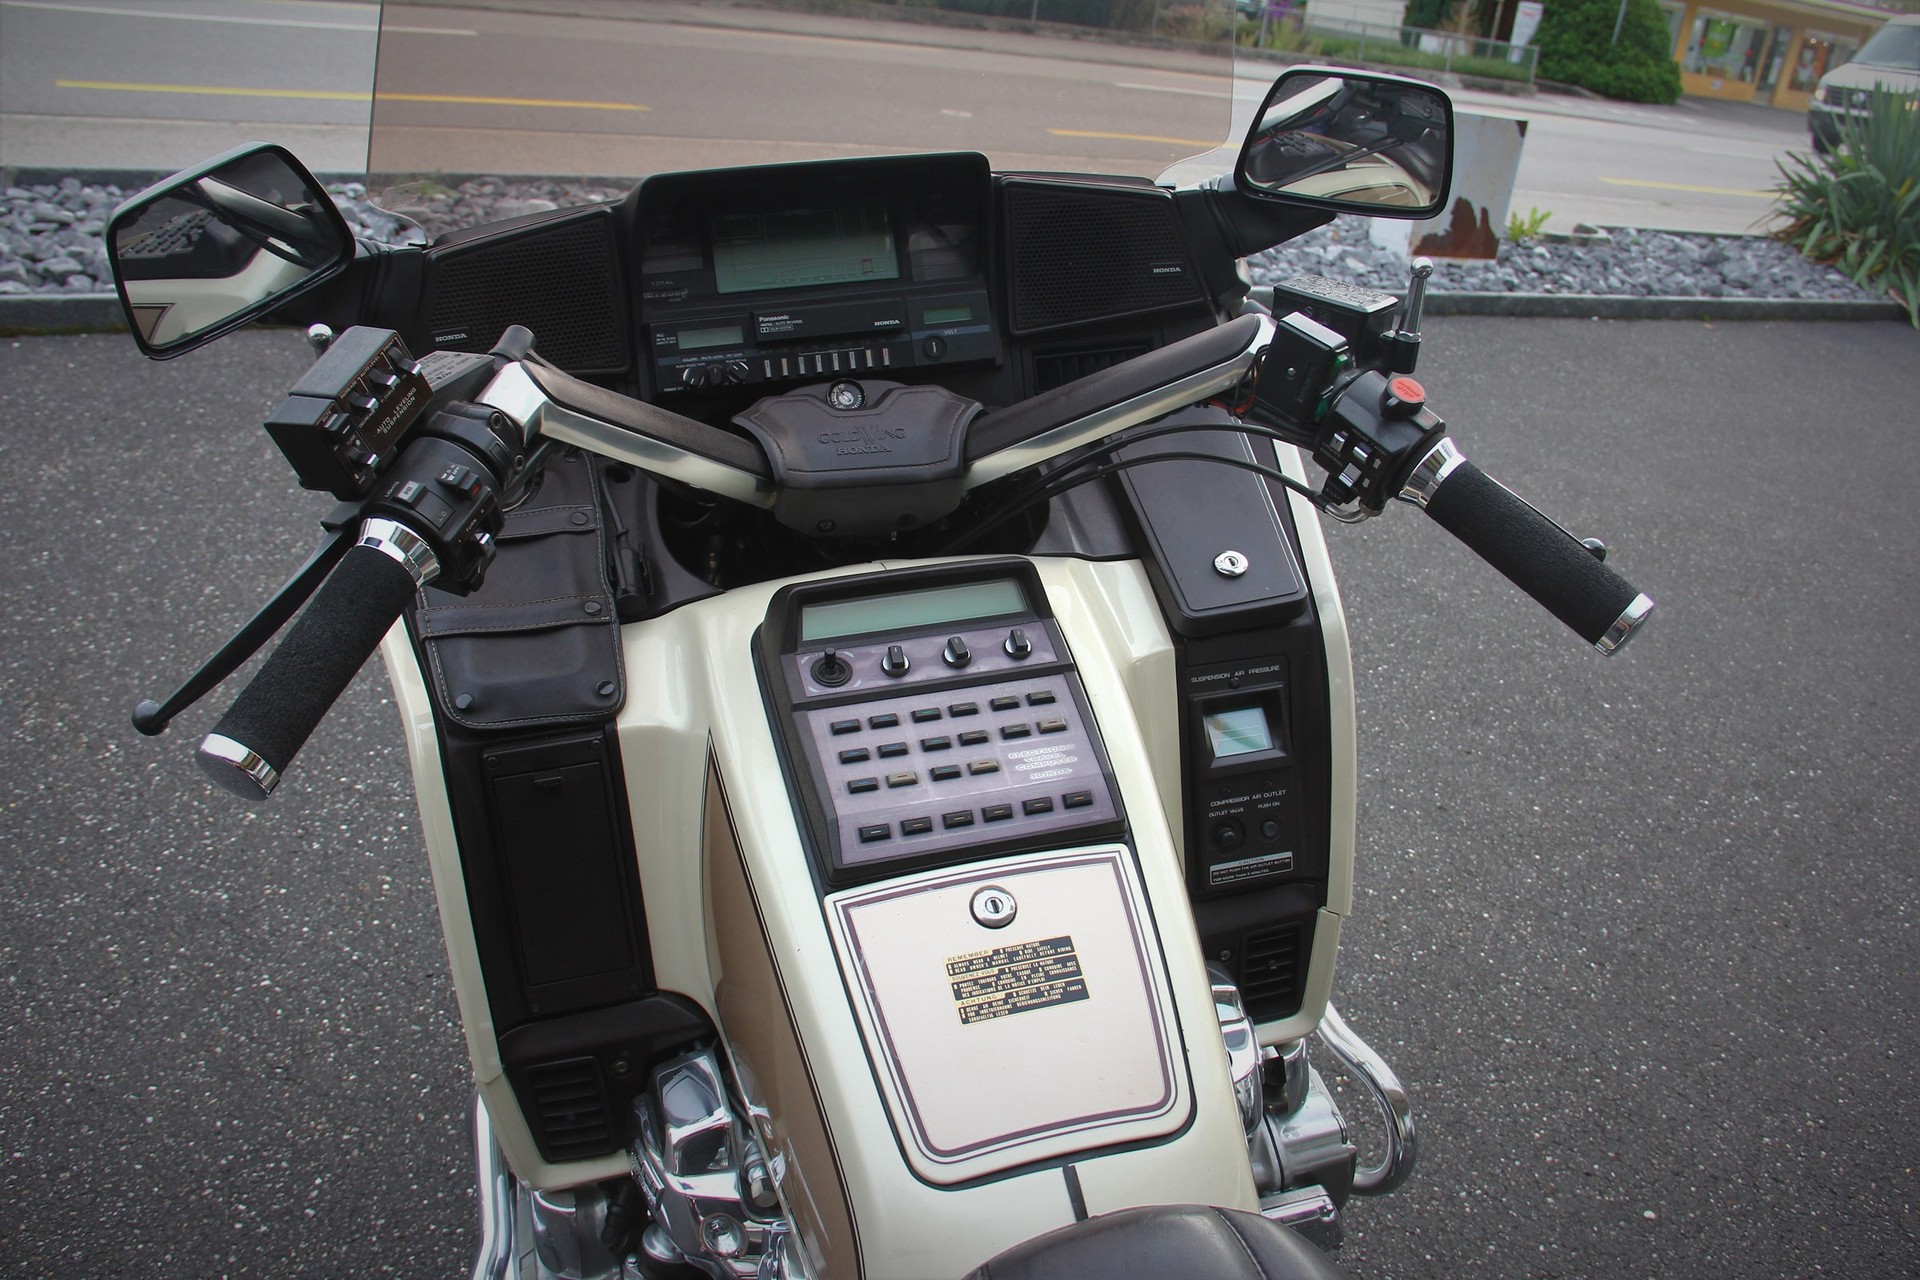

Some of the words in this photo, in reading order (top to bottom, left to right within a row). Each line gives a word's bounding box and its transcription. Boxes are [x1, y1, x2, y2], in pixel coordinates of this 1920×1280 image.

[436, 333, 467, 342] HONDA
[376, 416, 391, 433] AUTO
[393, 387, 417, 414] LEVELING
[383, 396, 415, 434] SUSPENSION
[835, 445, 891, 455] HONDA
[1191, 672, 1230, 683] SUSPENSION
[1249, 665, 1280, 675] PRESSURE
[1210, 795, 1249, 807] COMPRESSOR
[1264, 790, 1286, 798] OUTLET
[948, 950, 989, 962] REMEMBER
[960, 995, 997, 1006] ACHTUNG
